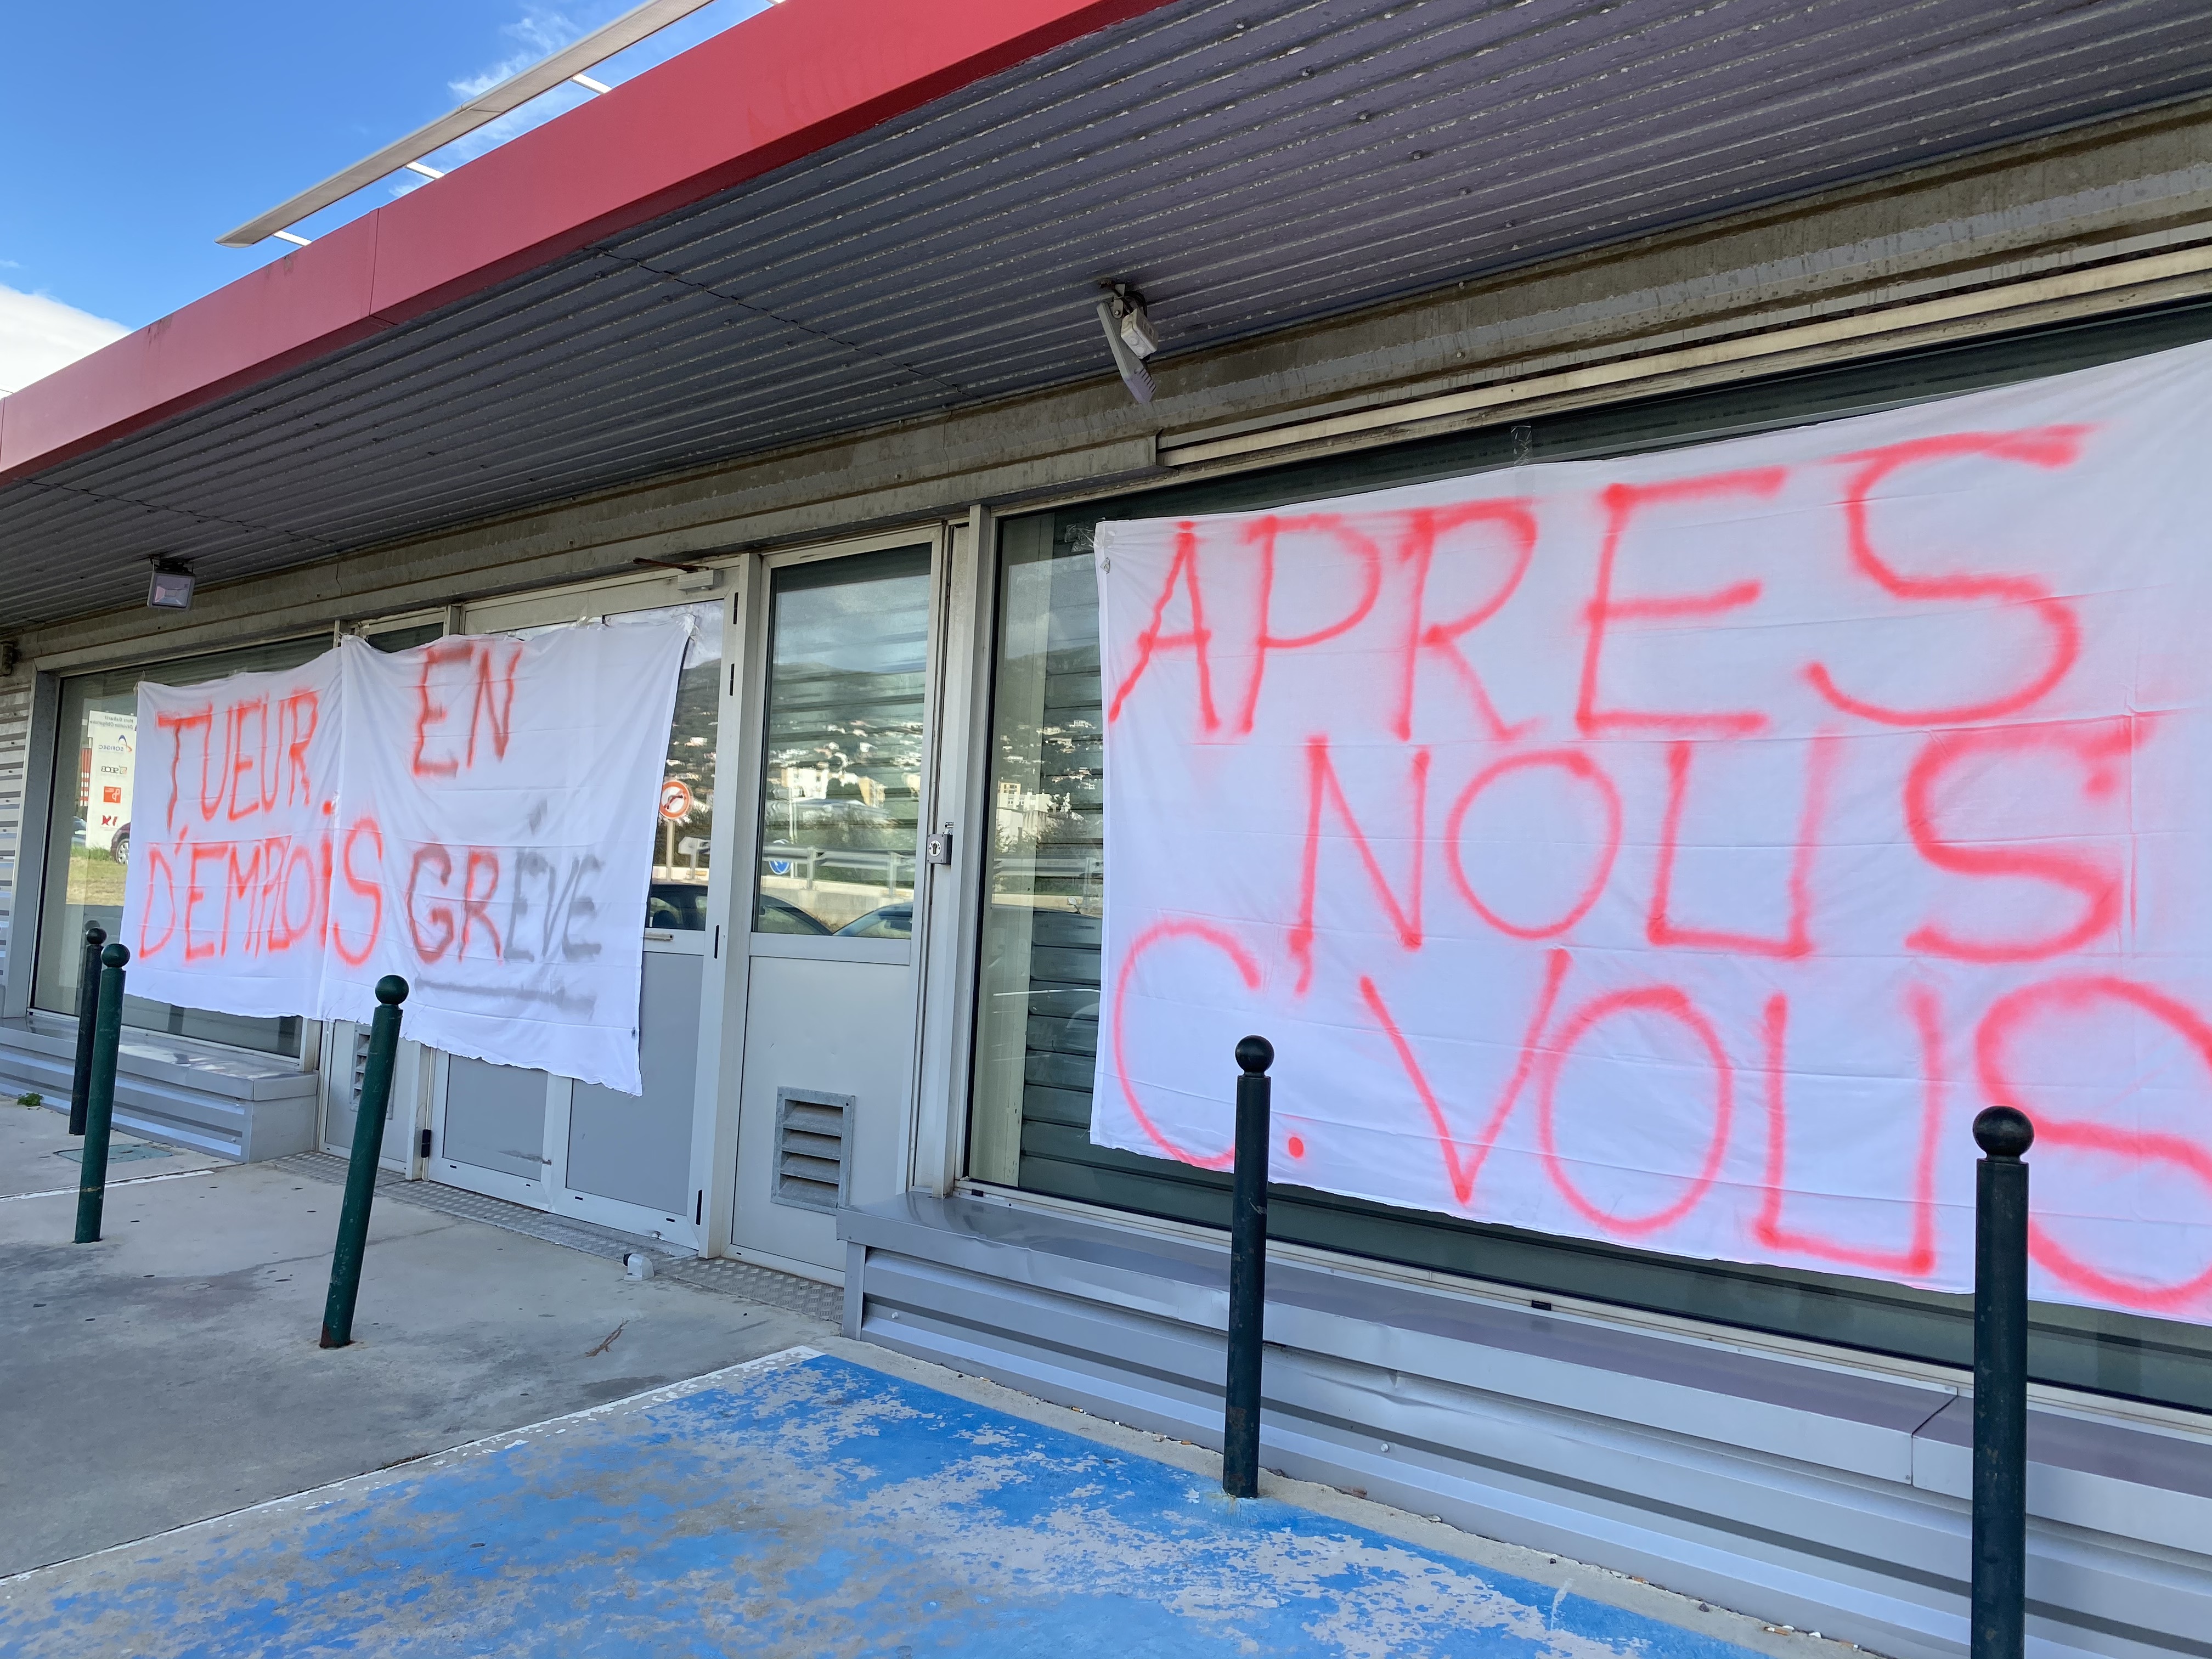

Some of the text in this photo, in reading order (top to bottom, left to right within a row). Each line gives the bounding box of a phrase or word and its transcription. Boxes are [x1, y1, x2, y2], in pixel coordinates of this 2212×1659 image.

[1108, 424, 2098, 742] APRES
[155, 687, 320, 832] TUEUR
[411, 640, 525, 778] EN
[1285, 718, 2145, 966] NOUS
[1361, 945, 2212, 1313] VOUS
